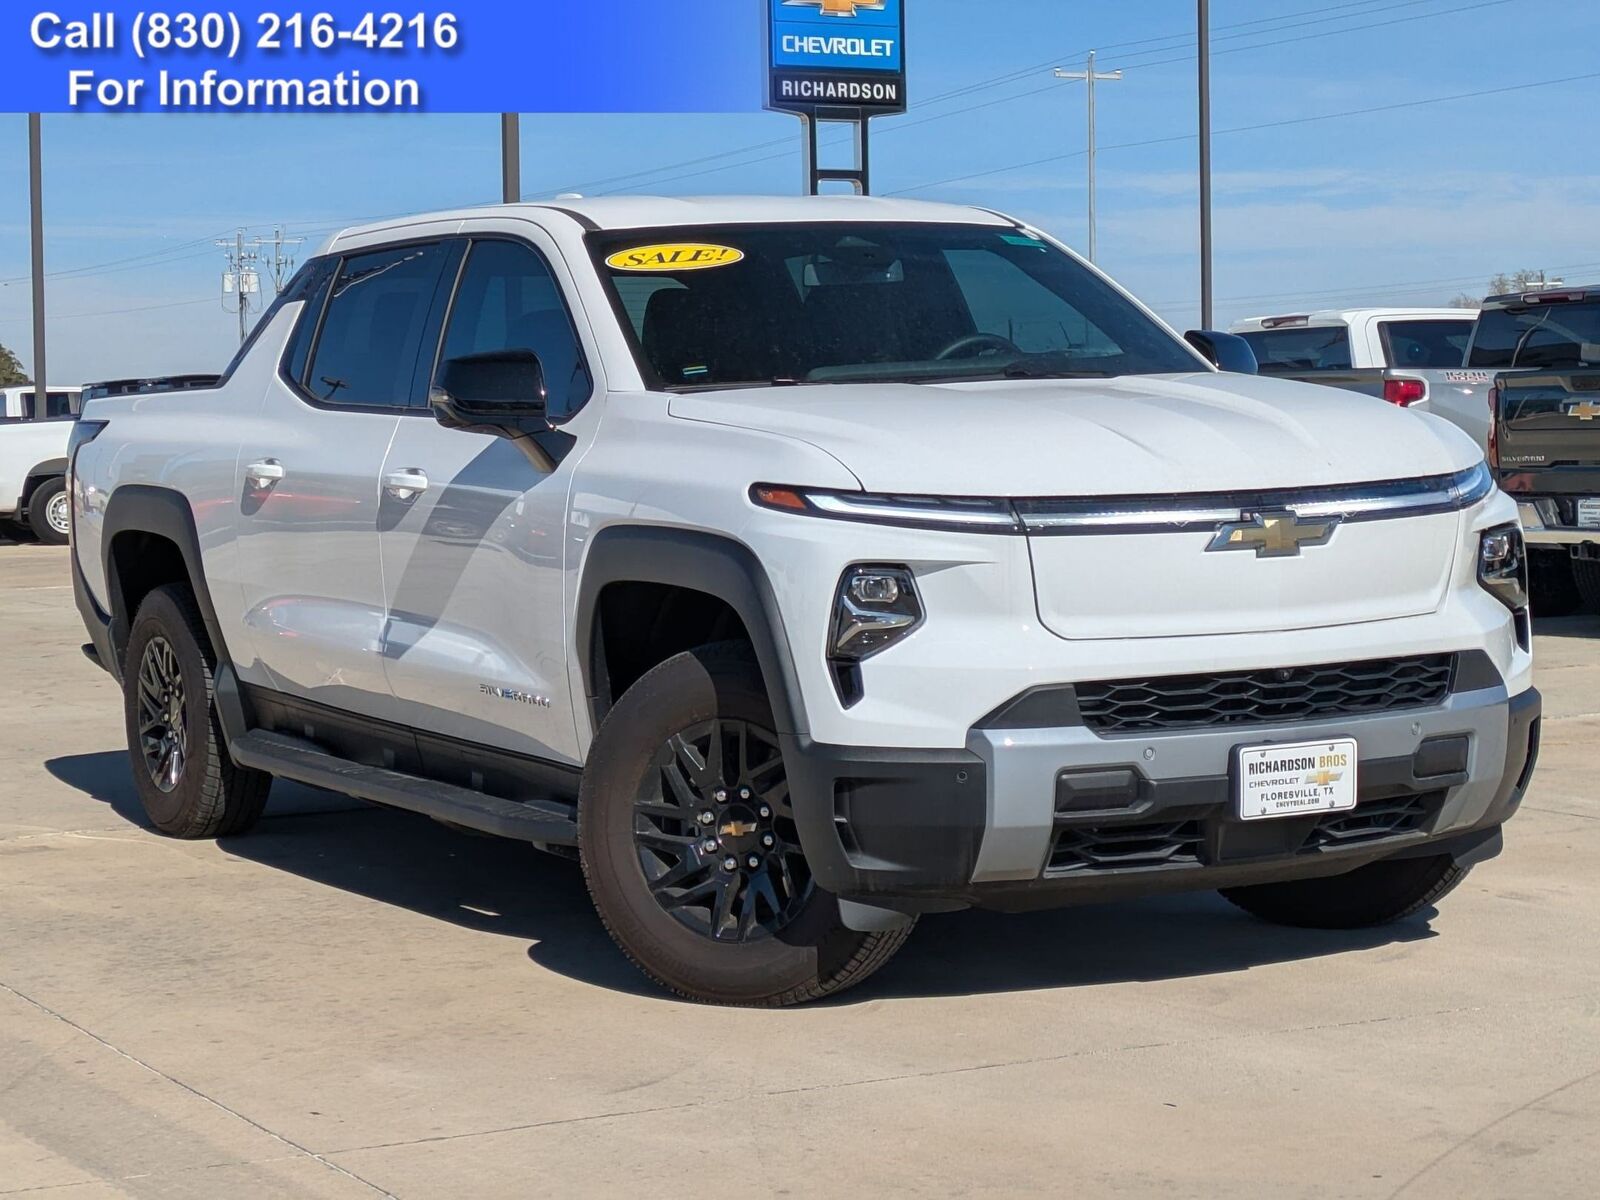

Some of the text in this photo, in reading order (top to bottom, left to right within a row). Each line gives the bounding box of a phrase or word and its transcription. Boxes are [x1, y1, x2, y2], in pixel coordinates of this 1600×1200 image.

[782, 35, 895, 57] CHEVROLET
[782, 80, 896, 100] RICHARDSON
[623, 249, 728, 266] SALE!
[1249, 754, 1347, 775] RICHARDSON BROS
[1249, 777, 1300, 788] CHEVROLET
[1323, 786, 1334, 796] TX
